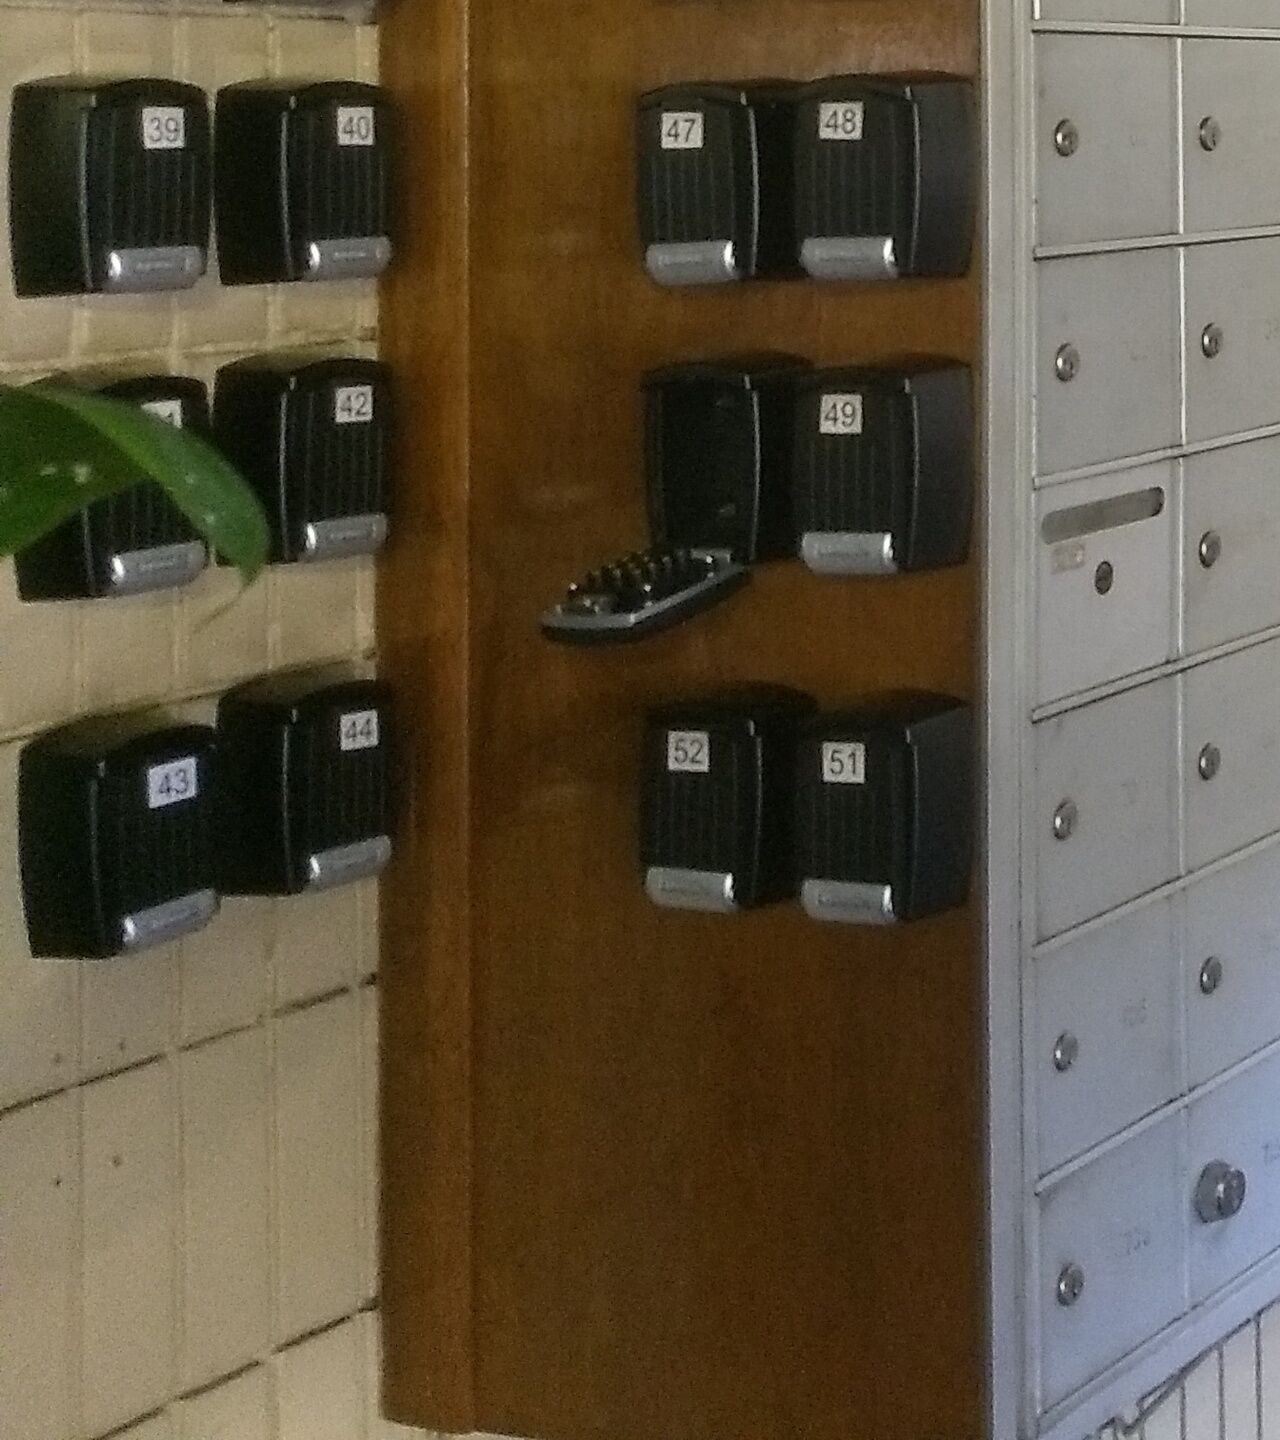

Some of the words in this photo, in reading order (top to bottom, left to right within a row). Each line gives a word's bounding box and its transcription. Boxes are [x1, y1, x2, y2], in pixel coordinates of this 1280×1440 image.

[149, 116, 181, 143] 39
[342, 115, 371, 141] 40
[665, 117, 698, 143] 47
[824, 108, 857, 135] 48
[340, 391, 368, 416] 42
[823, 400, 857, 427] 49
[345, 717, 372, 744] 44
[673, 735, 705, 765] 52
[829, 748, 857, 775] 51
[156, 768, 190, 799] 43
